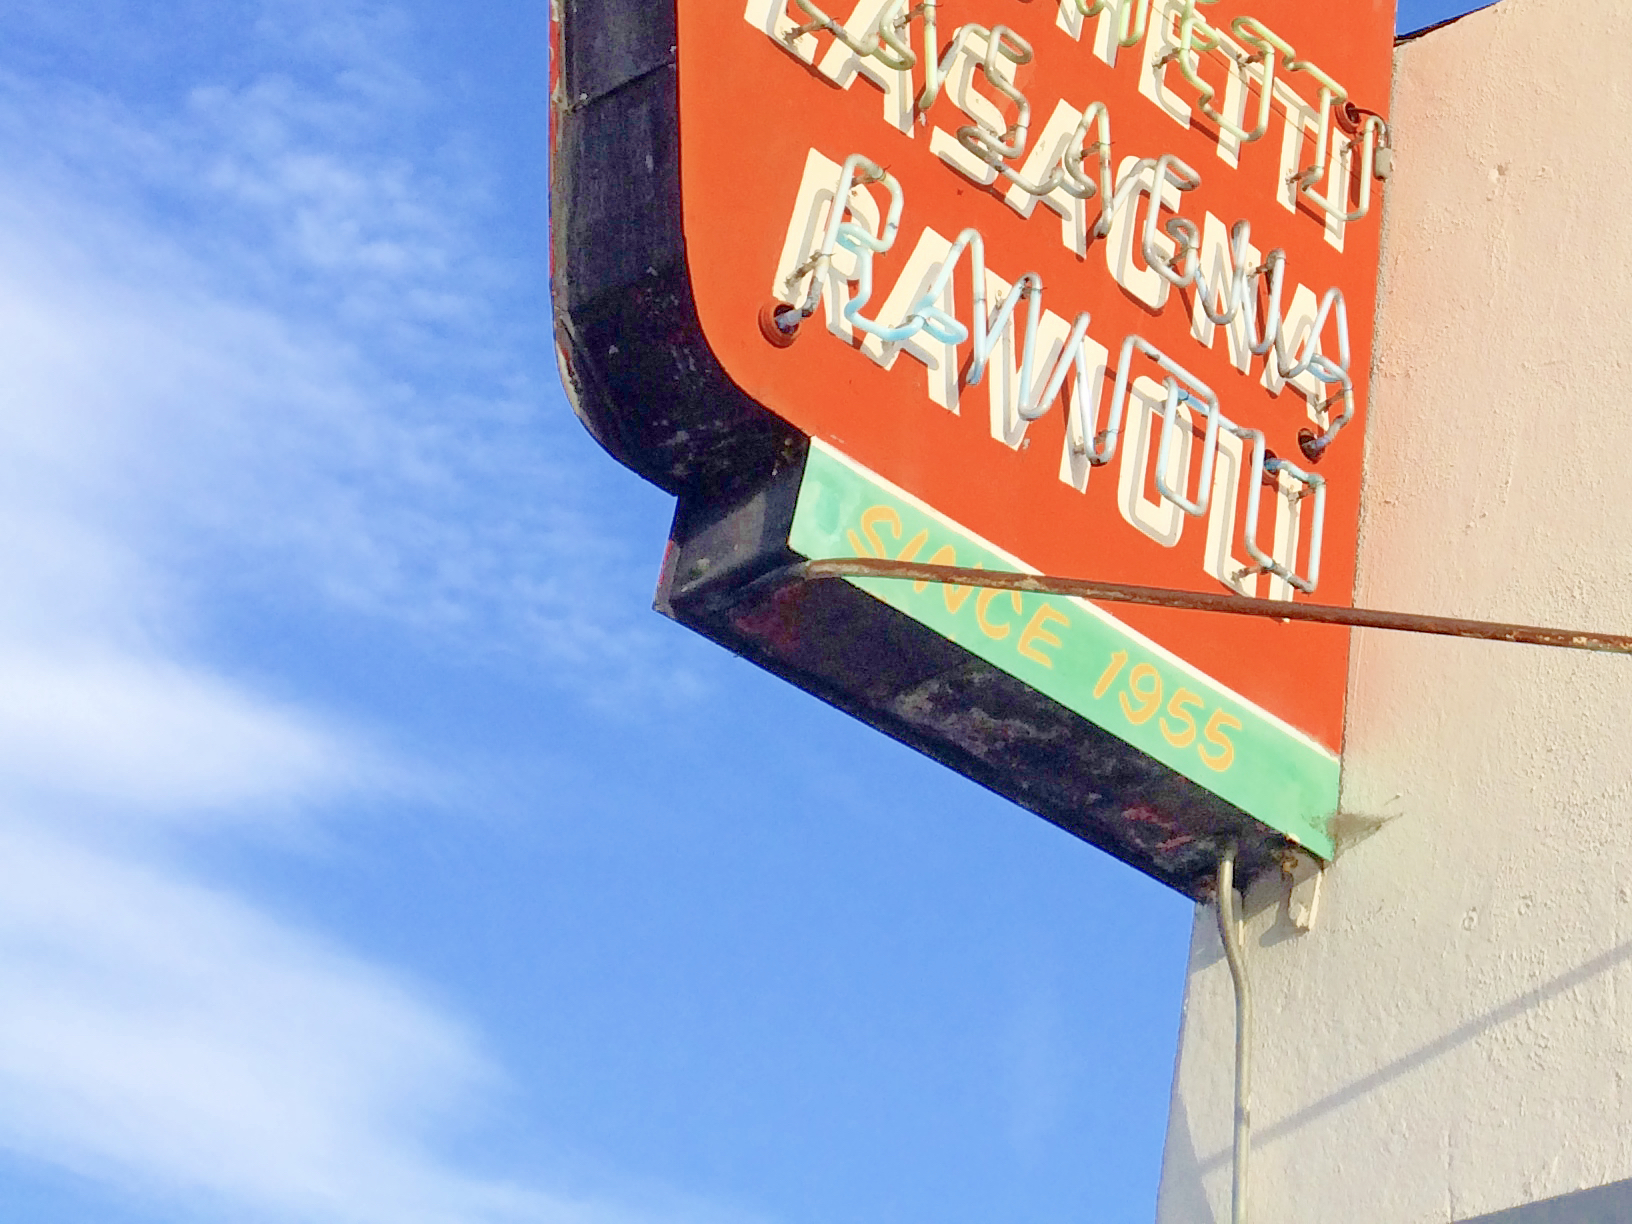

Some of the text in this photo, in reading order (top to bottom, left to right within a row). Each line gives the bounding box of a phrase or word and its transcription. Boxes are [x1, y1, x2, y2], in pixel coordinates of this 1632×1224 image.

[772, 147, 1325, 621] RAVIOLI
[847, 505, 1242, 771] SINCE 1955
